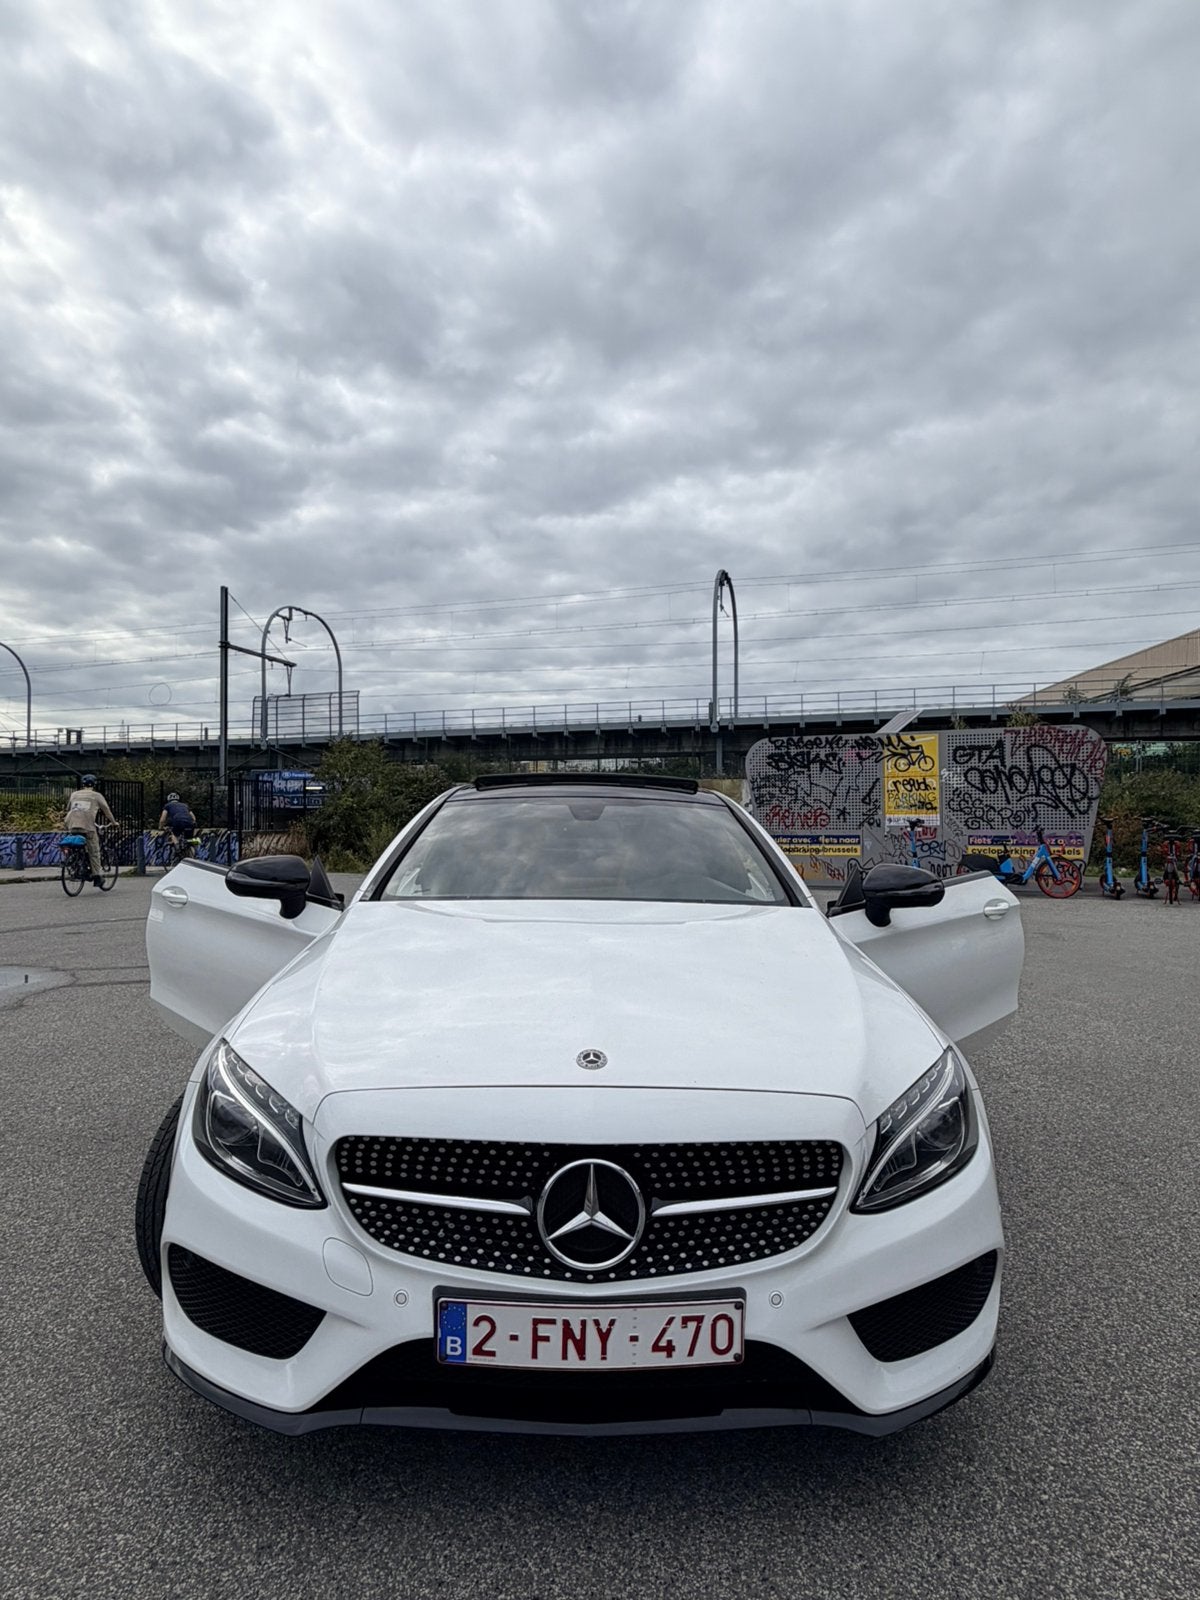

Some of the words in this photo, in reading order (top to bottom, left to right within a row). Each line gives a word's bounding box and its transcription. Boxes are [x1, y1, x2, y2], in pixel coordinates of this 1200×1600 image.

[888, 792, 937, 802] PARKING
[446, 1335, 462, 1355] B
[471, 1313, 735, 1361] 2-FNY-470
